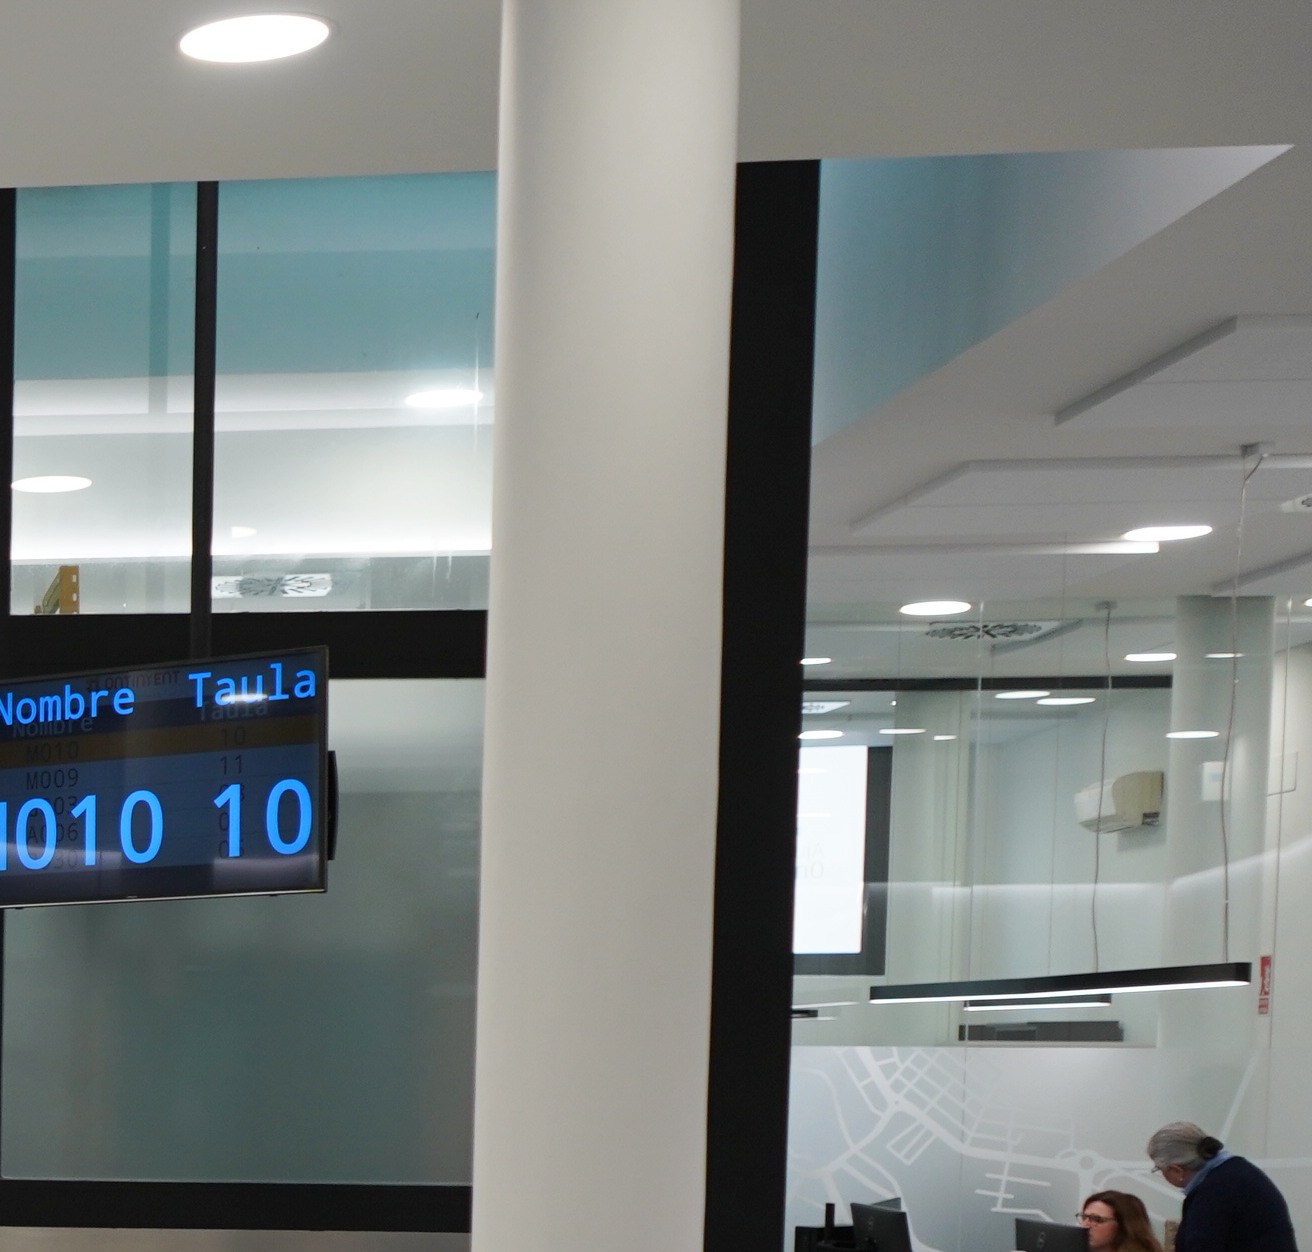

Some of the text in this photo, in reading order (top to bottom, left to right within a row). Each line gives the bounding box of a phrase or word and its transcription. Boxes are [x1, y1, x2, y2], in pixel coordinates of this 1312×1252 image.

[188, 662, 316, 708] Taula
[26, 754, 243, 790] M009 11
[213, 778, 313, 858] 10
